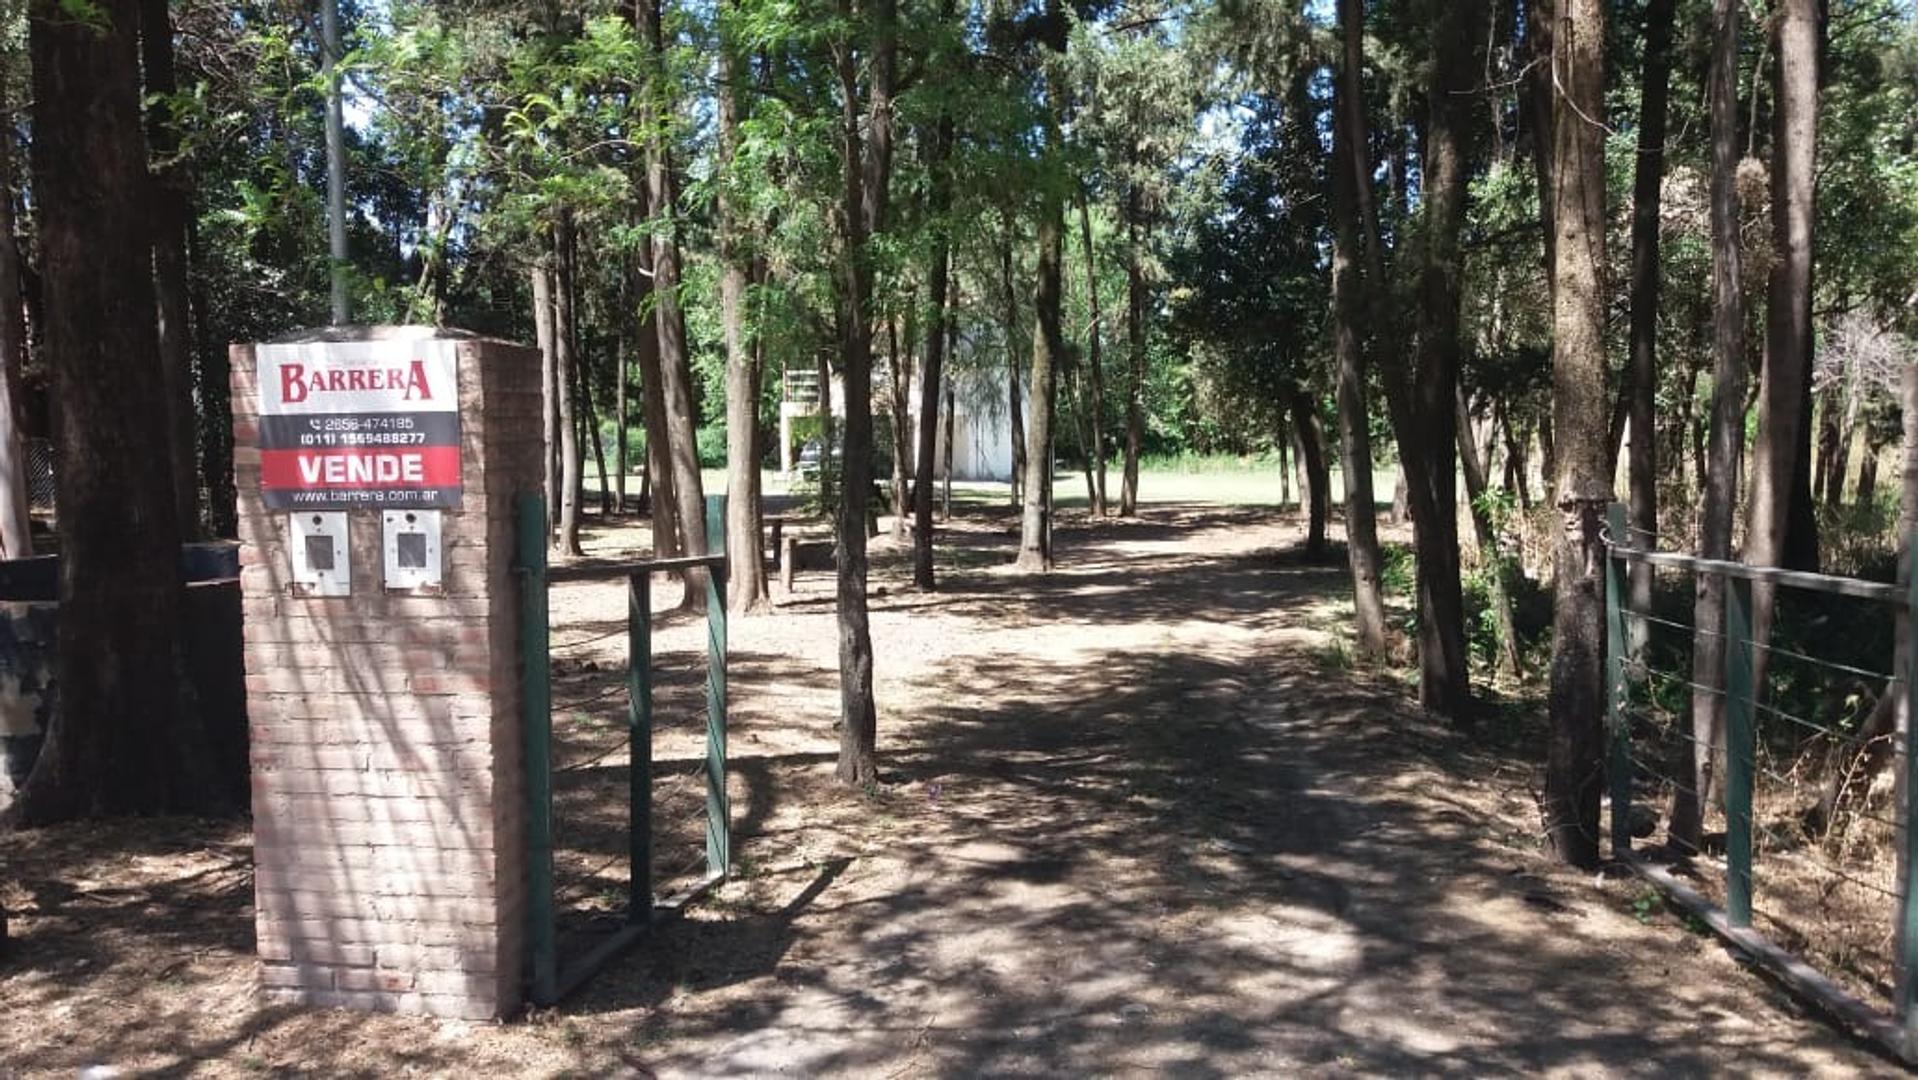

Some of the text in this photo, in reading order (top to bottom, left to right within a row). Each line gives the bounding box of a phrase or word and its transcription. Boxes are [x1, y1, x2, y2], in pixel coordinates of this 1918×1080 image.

[279, 360, 433, 403] BARRERA
[301, 433, 336, 445] (011)
[298, 454, 423, 483] VENDE
[293, 490, 438, 502] www.barrera.com.ar
